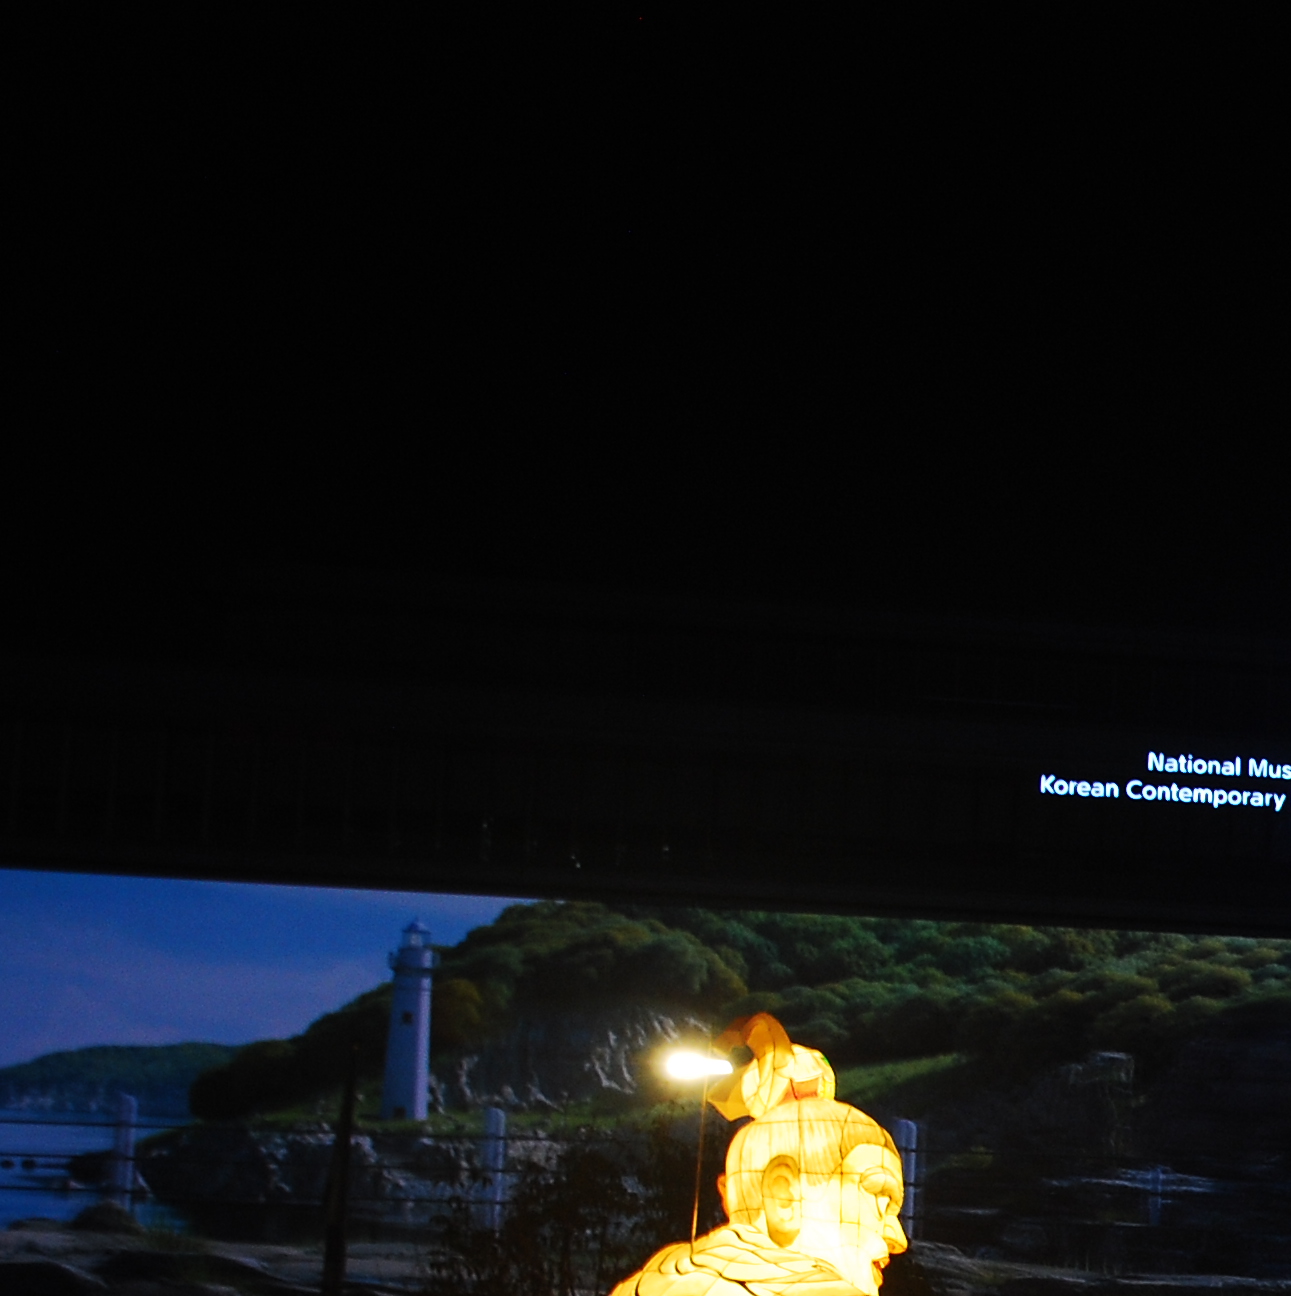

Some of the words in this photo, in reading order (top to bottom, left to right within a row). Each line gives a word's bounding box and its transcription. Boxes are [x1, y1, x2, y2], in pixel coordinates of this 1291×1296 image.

[1147, 751, 1242, 777] National
[1039, 774, 1120, 798] Korean
[1125, 779, 1287, 812] Contemporary
